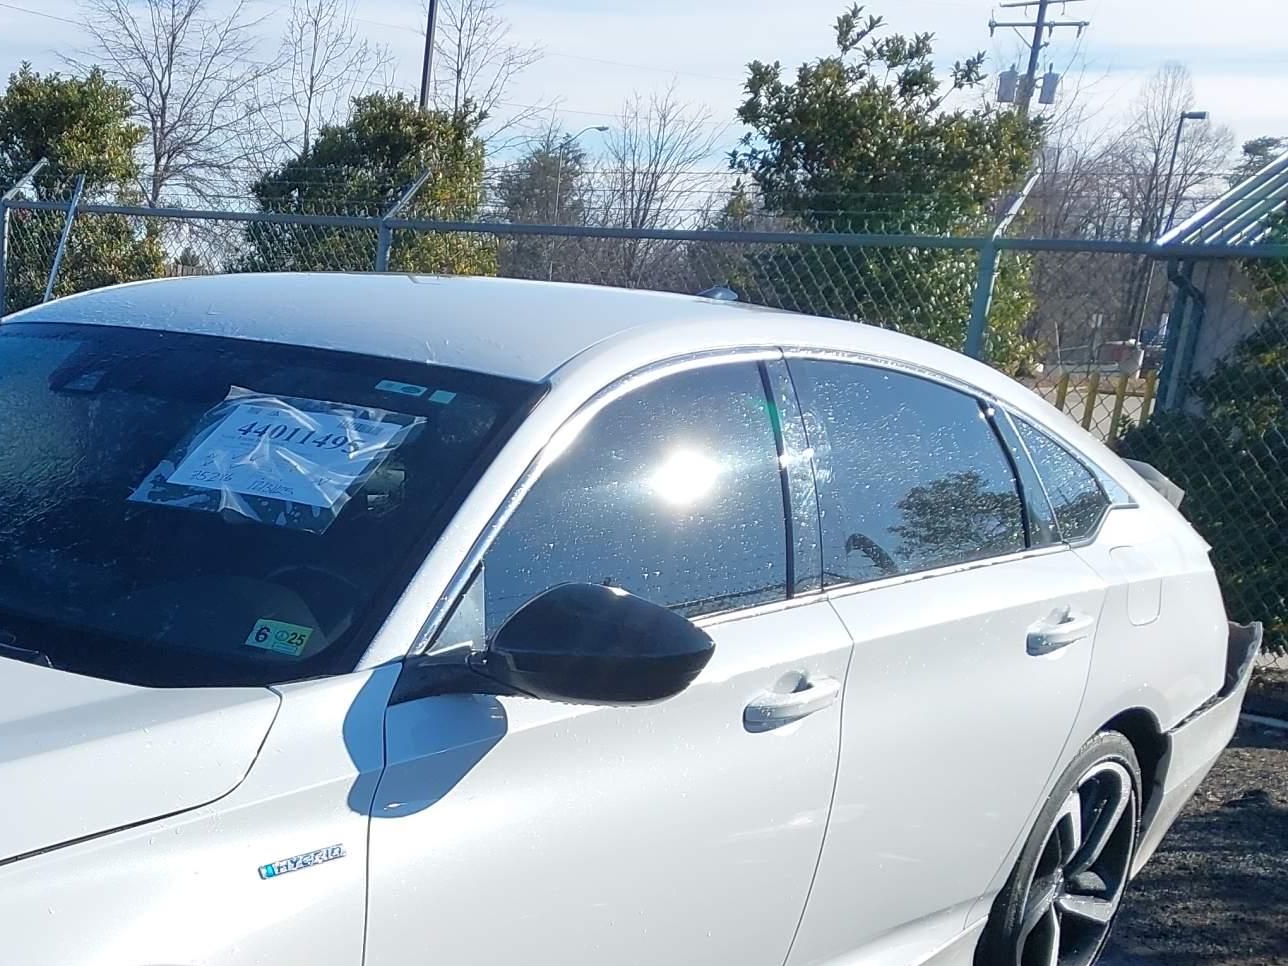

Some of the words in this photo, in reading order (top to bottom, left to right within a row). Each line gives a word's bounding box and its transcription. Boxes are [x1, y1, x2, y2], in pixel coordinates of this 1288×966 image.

[237, 421, 366, 454] 44011495
[255, 627, 271, 643] 6
[287, 632, 306, 646] 25
